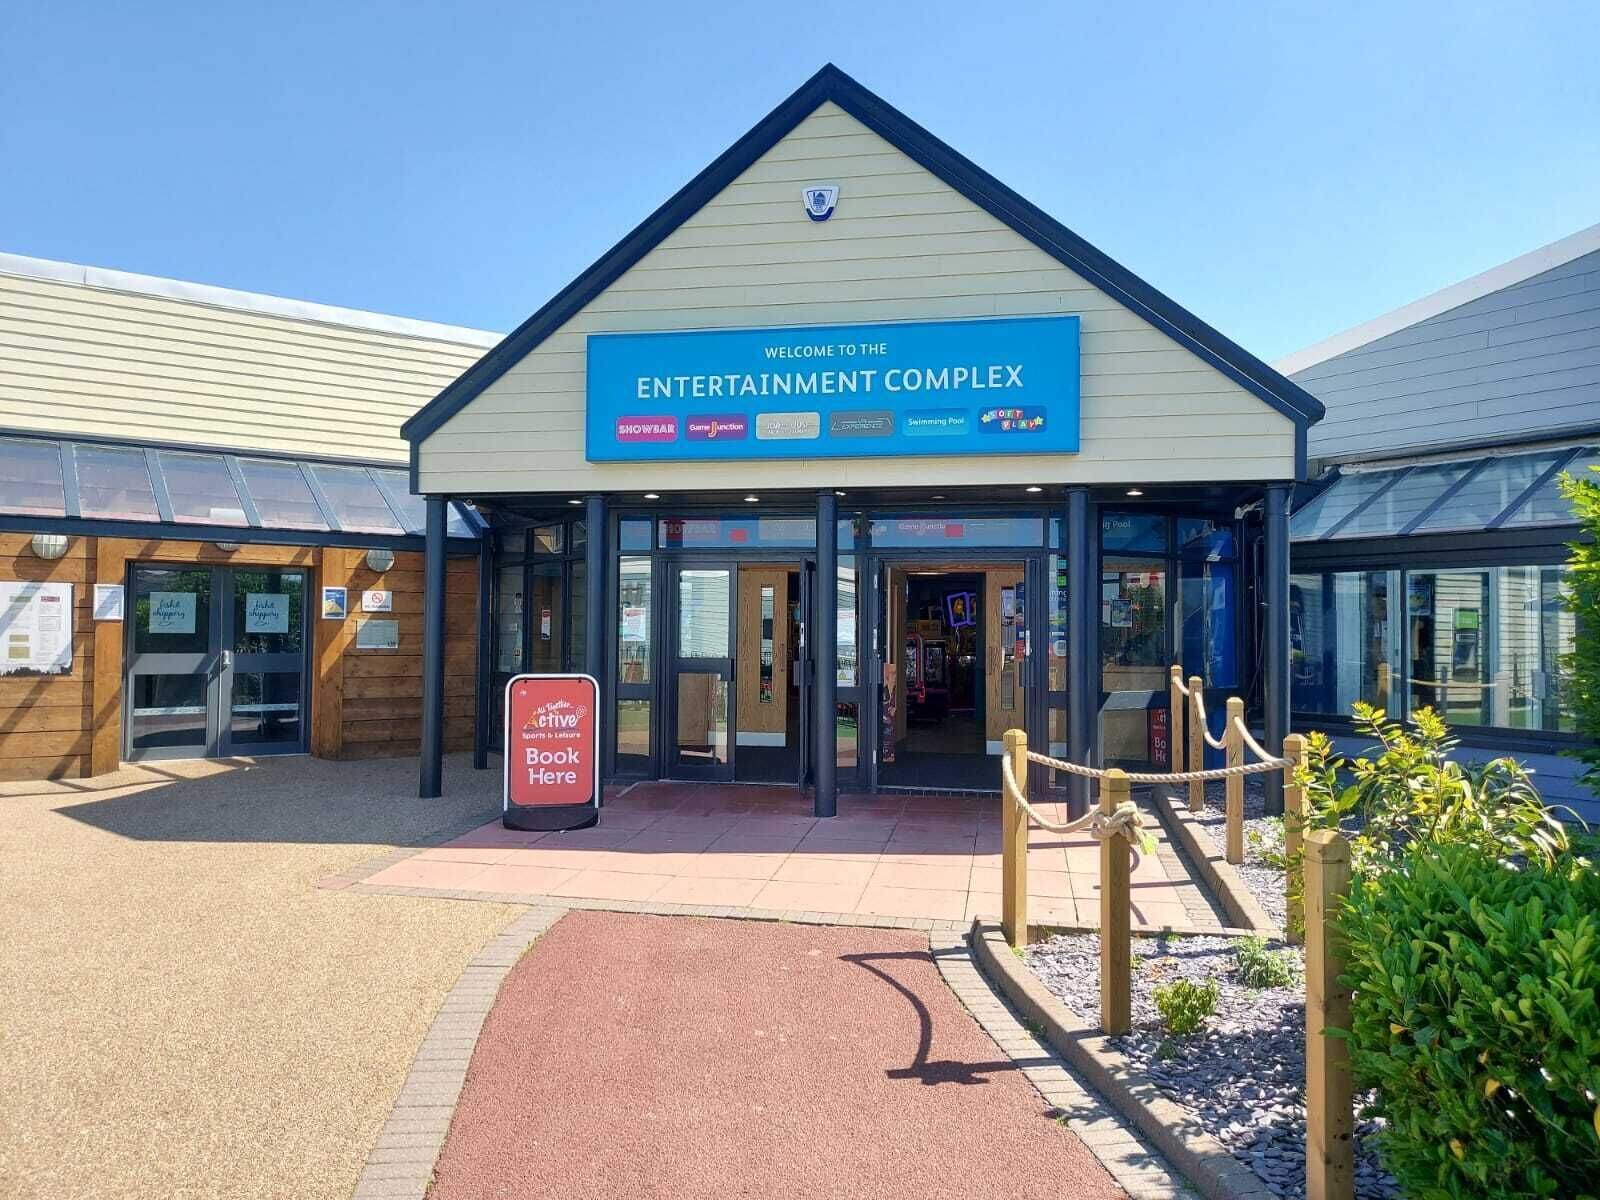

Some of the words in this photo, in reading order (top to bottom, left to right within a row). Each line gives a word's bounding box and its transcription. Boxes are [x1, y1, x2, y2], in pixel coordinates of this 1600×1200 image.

[764, 345, 834, 359] WELCOME
[838, 344, 857, 356] TO
[860, 343, 888, 356] THE
[637, 370, 877, 398] ENTERTAINMENT
[884, 365, 1024, 391] COMPLEX
[618, 422, 675, 435] SHOWBAR
[907, 416, 945, 427] Swimming
[948, 415, 965, 425] Pool
[523, 710, 576, 729] Active
[523, 732, 545, 740] Sports
[554, 731, 581, 739] Leisure
[525, 747, 580, 765] Book
[528, 767, 577, 785] Here
